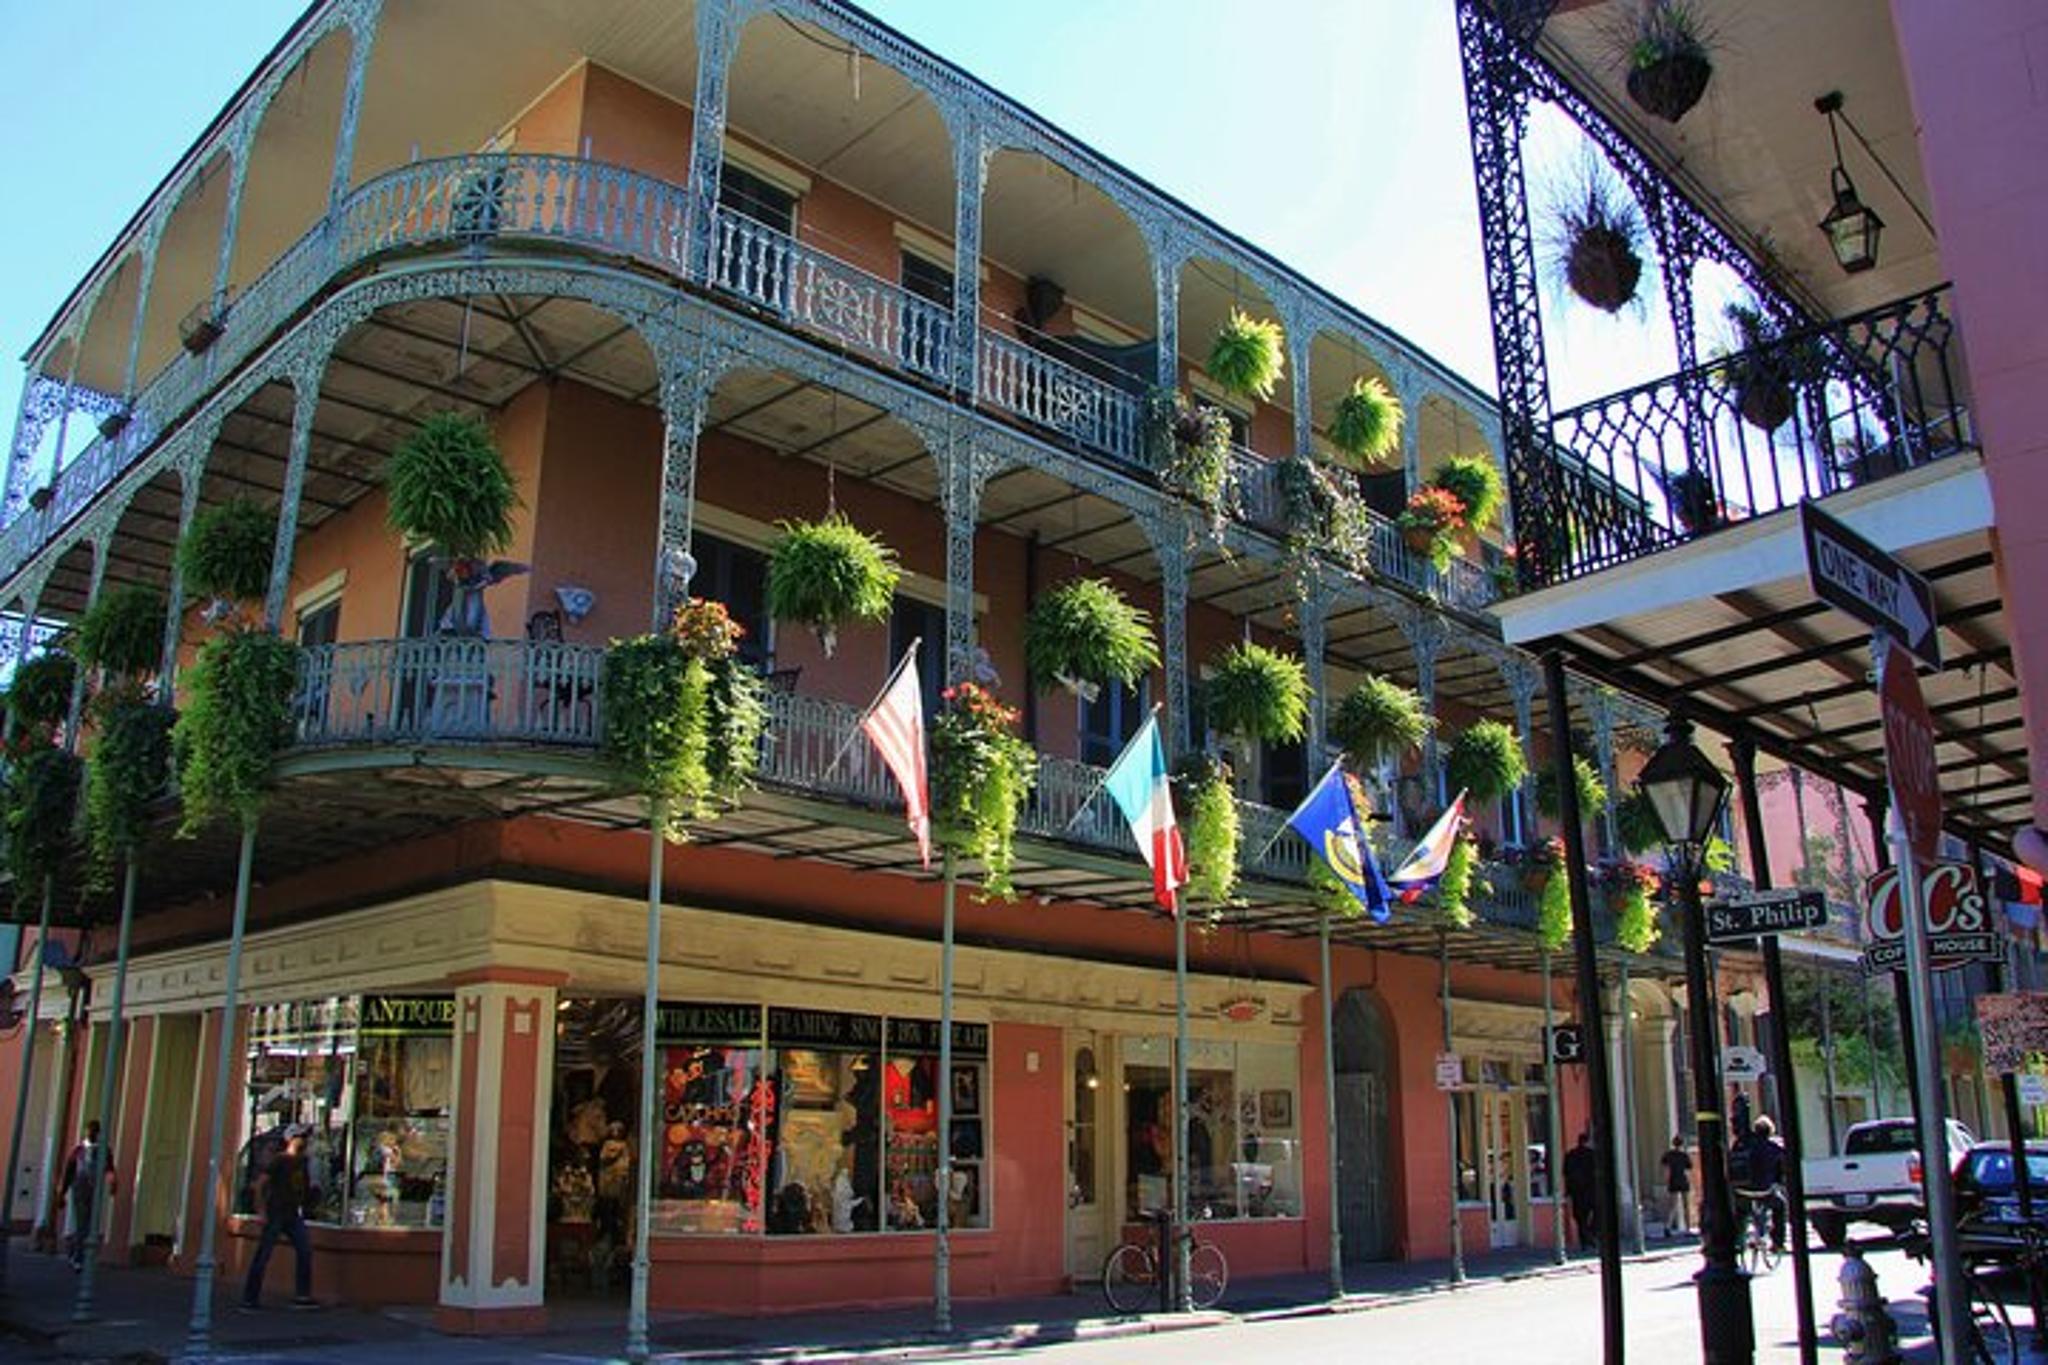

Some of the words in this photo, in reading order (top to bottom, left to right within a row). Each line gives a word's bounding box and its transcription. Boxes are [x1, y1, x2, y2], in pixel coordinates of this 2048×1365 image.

[1820, 539, 1862, 594] ONE
[1863, 564, 1899, 618] WAY
[1712, 910, 1740, 930] St.
[1750, 900, 1819, 931] Philip
[1933, 939, 1986, 954] HOUSE
[365, 999, 456, 1025] ANTIQUE
[655, 1007, 761, 1034] WHOLESALE
[1552, 1029, 1581, 1059] G
